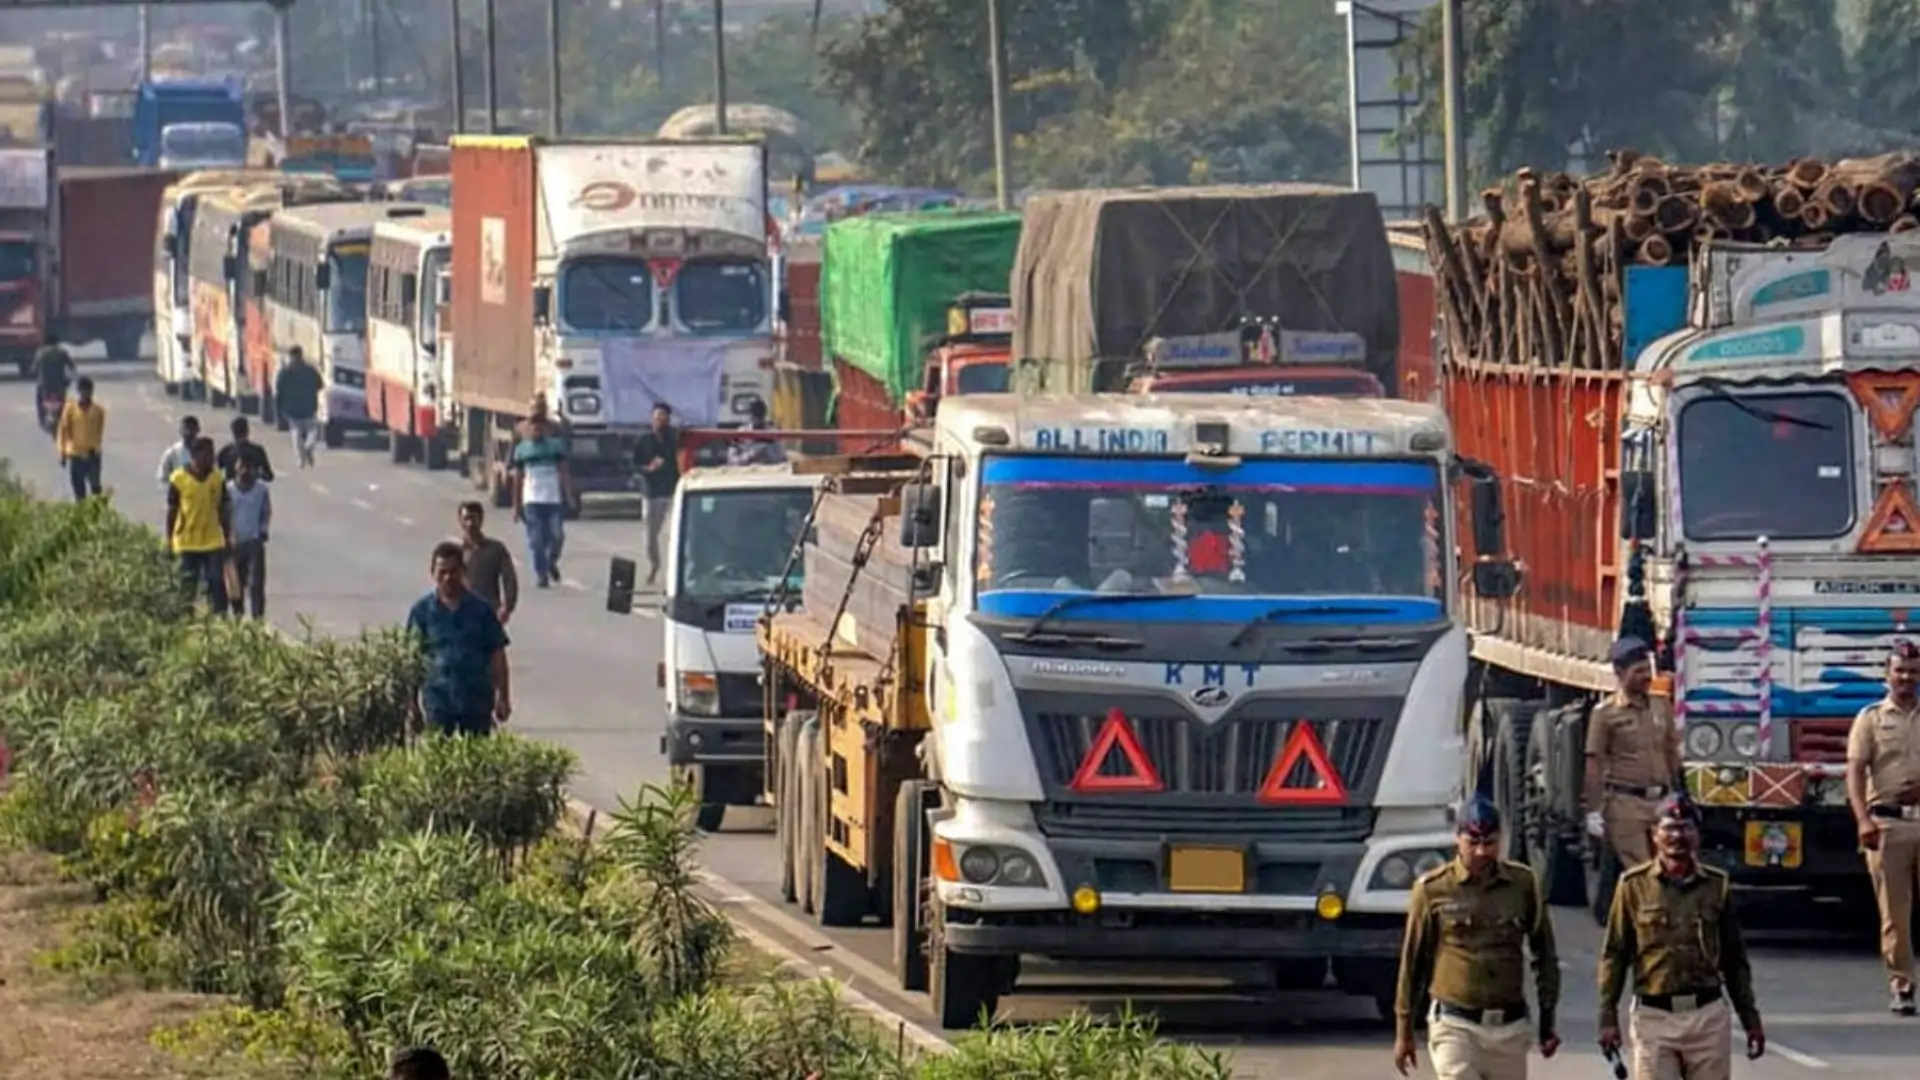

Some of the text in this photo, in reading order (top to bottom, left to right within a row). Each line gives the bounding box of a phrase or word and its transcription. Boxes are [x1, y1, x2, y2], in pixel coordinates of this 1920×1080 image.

[1036, 428, 1376, 453] ALL INDIA PERMIT
